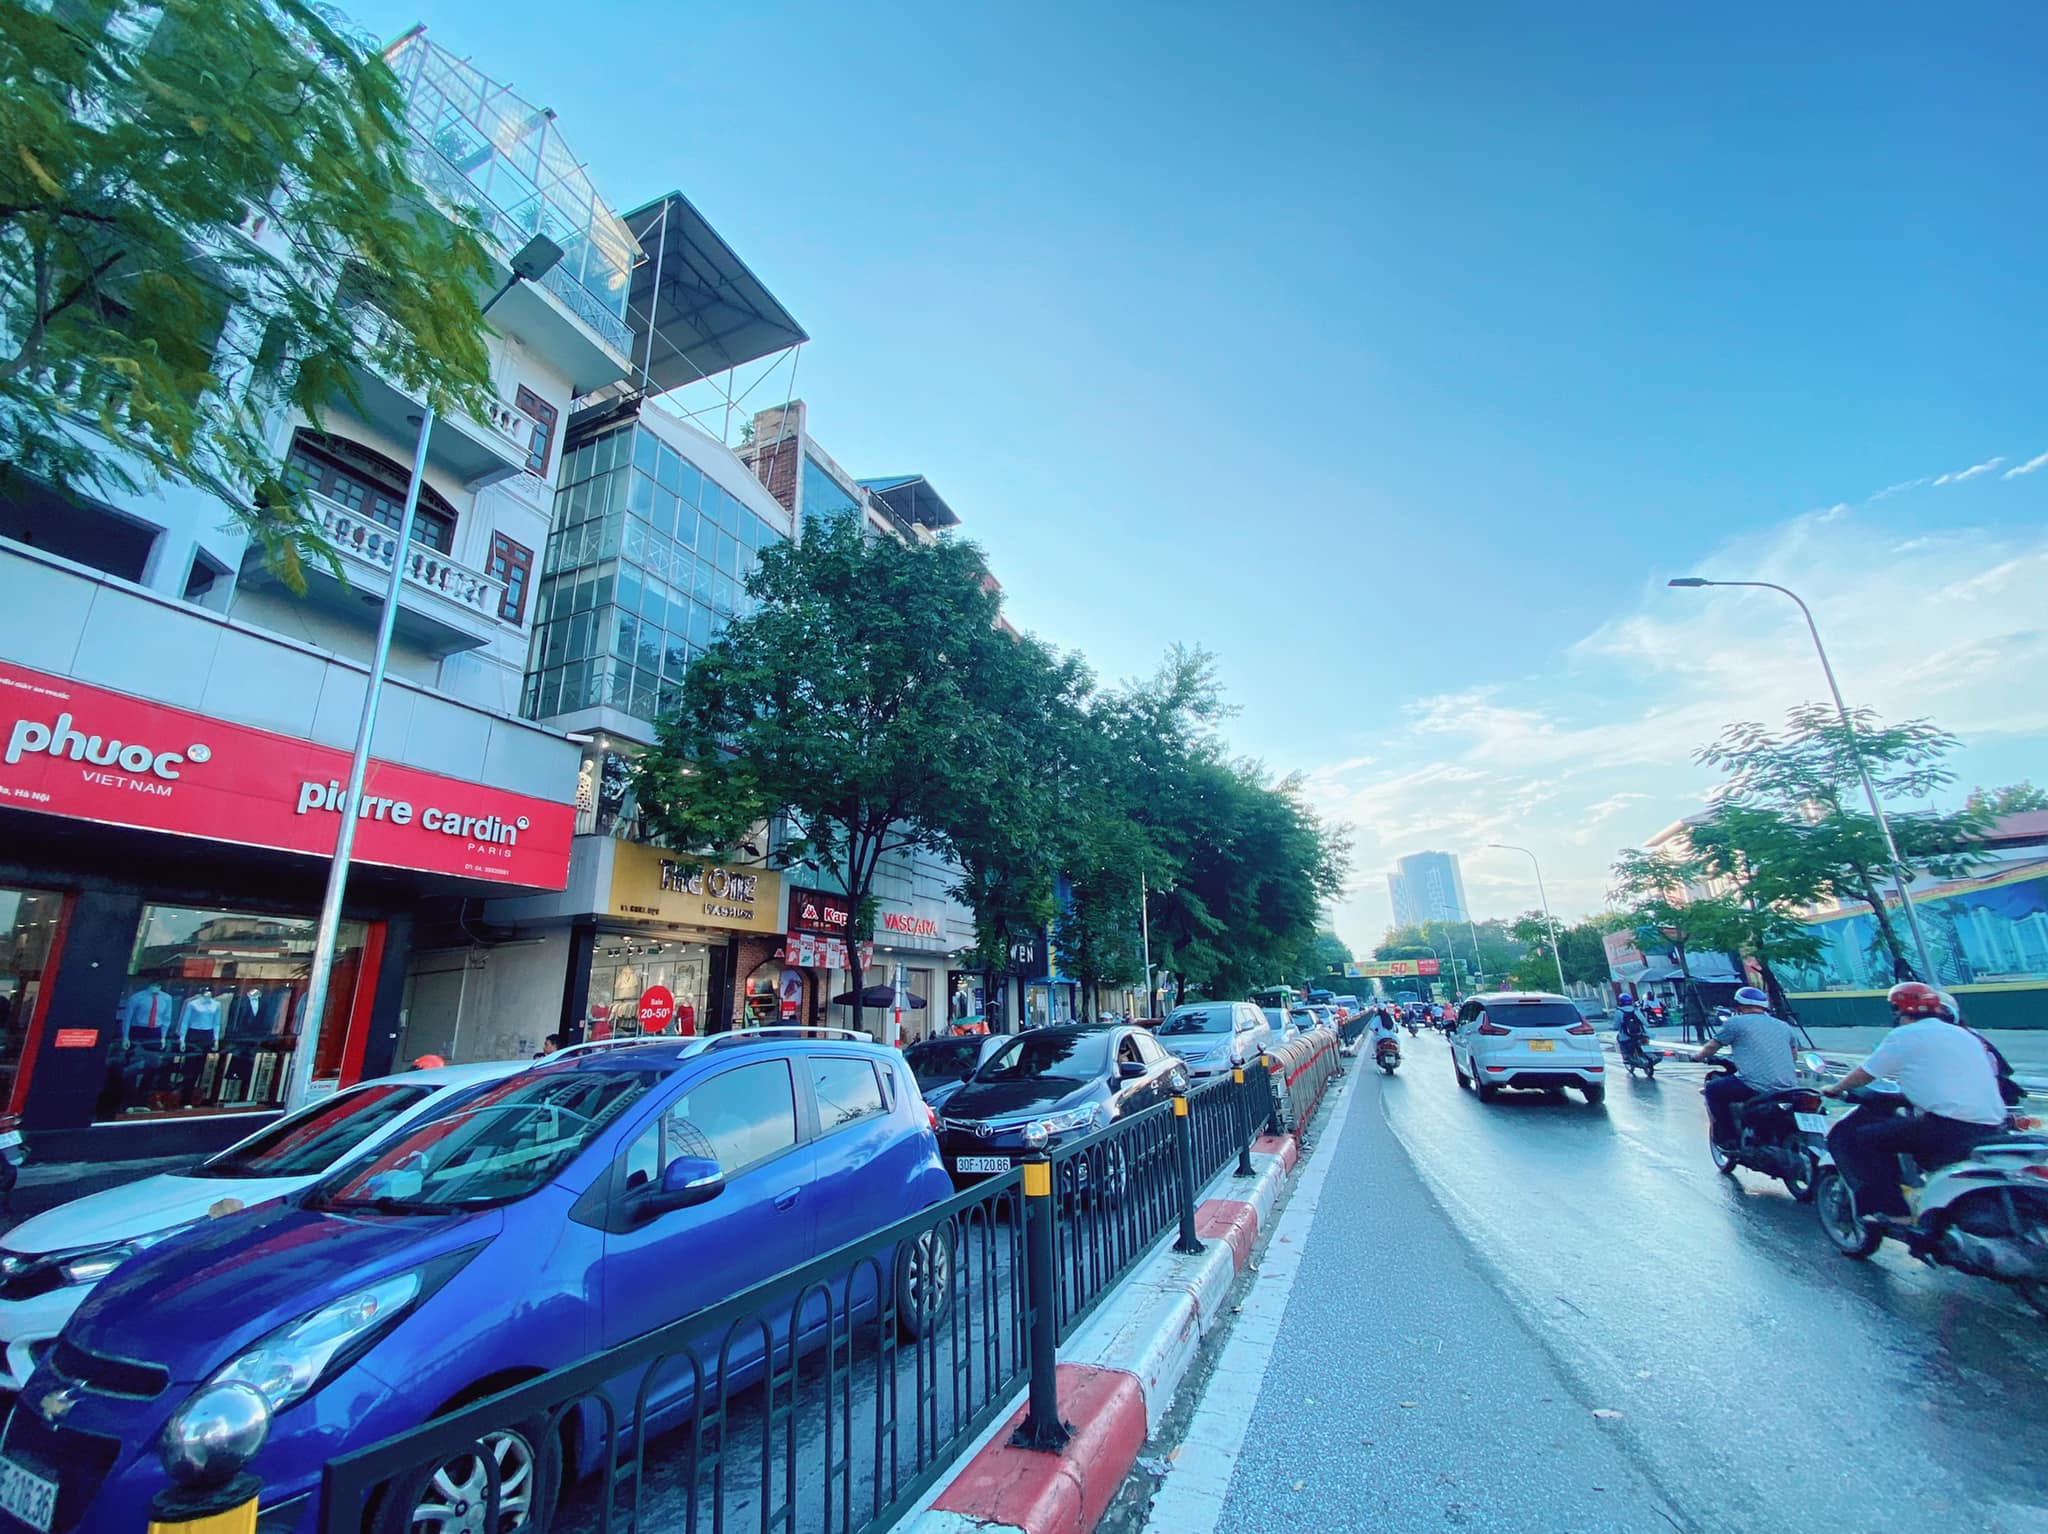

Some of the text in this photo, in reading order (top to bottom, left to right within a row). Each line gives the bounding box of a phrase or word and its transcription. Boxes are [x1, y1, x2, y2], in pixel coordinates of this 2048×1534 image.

[4, 712, 184, 780] phuoc
[82, 770, 173, 797] VIET NAM
[422, 807, 518, 846] cardin
[467, 842, 512, 858] PARIS
[882, 912, 939, 937] VASCARA
[958, 1158, 1009, 1171] 30F-120.86
